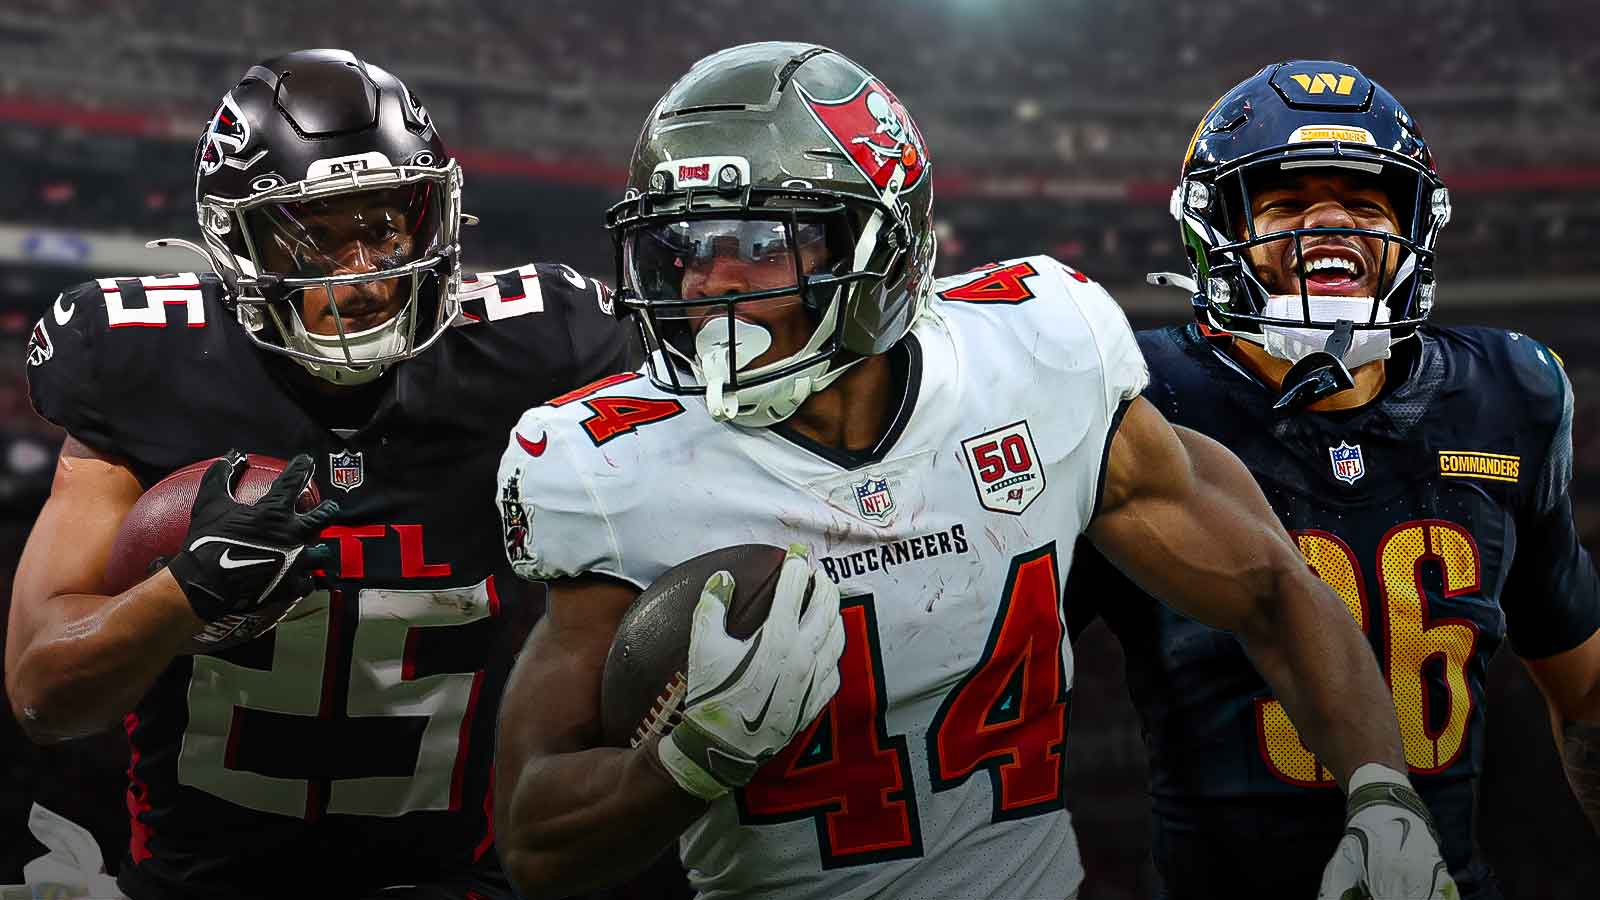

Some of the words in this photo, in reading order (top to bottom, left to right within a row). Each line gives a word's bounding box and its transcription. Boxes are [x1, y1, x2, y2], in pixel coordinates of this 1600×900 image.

[335, 468, 360, 483] NFL
[972, 433, 1033, 484] 50
[1337, 460, 1360, 477] NFL
[1439, 455, 1520, 478] COMMANDERS
[863, 494, 891, 513] NFL
[310, 523, 453, 578] TL
[818, 523, 969, 585] BUCCANEERS
[178, 574, 499, 824] 25
[733, 540, 1073, 871] 44
